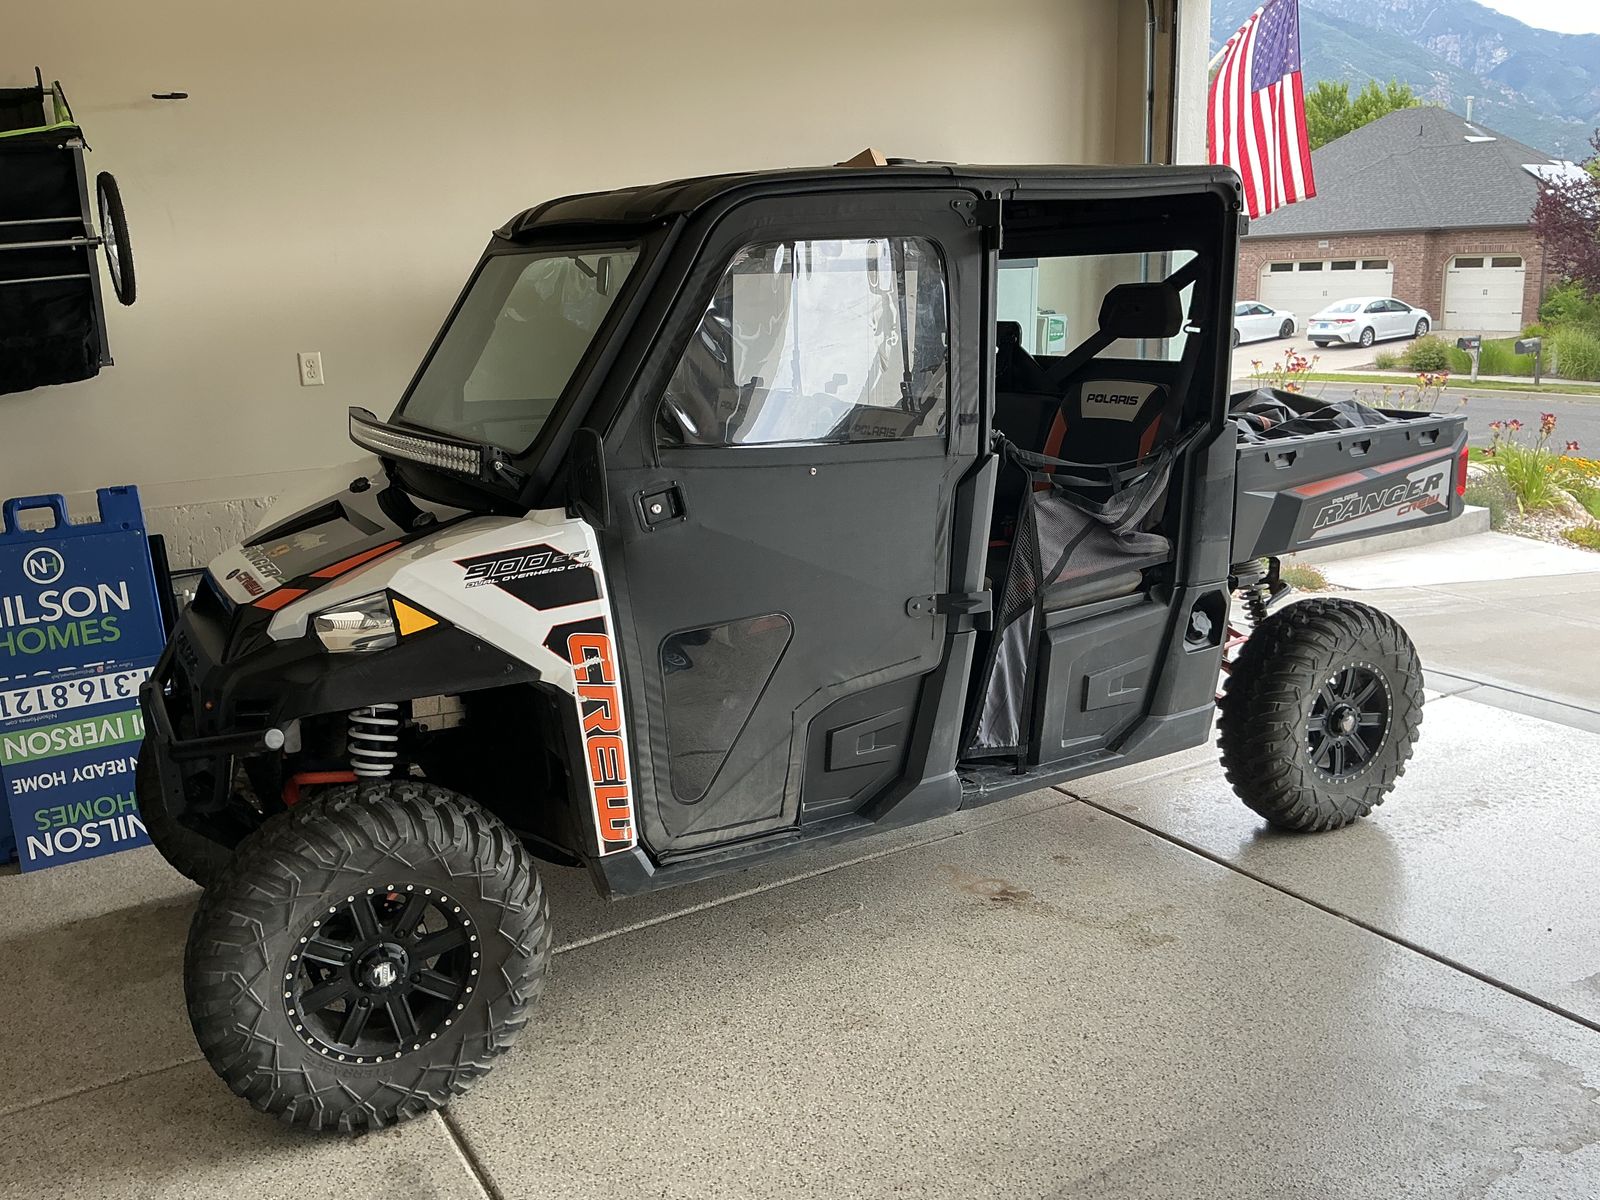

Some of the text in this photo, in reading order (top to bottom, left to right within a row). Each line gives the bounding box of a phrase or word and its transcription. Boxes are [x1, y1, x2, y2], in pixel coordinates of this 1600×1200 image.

[1086, 393, 1139, 406] POLARIS
[855, 424, 897, 438] POLARIS
[1312, 472, 1444, 529] RANGER
[1396, 494, 1441, 516] CREW
[463, 549, 591, 580] 900 EFI
[465, 560, 594, 589] DUAL OVERHEAD CAM
[0, 581, 131, 628] ILSON
[3, 717, 125, 760] IVERSON
[567, 632, 633, 843] CREW
[11, 770, 67, 795] HOME
[72, 758, 127, 783] READY
[34, 791, 138, 831] HOMES
